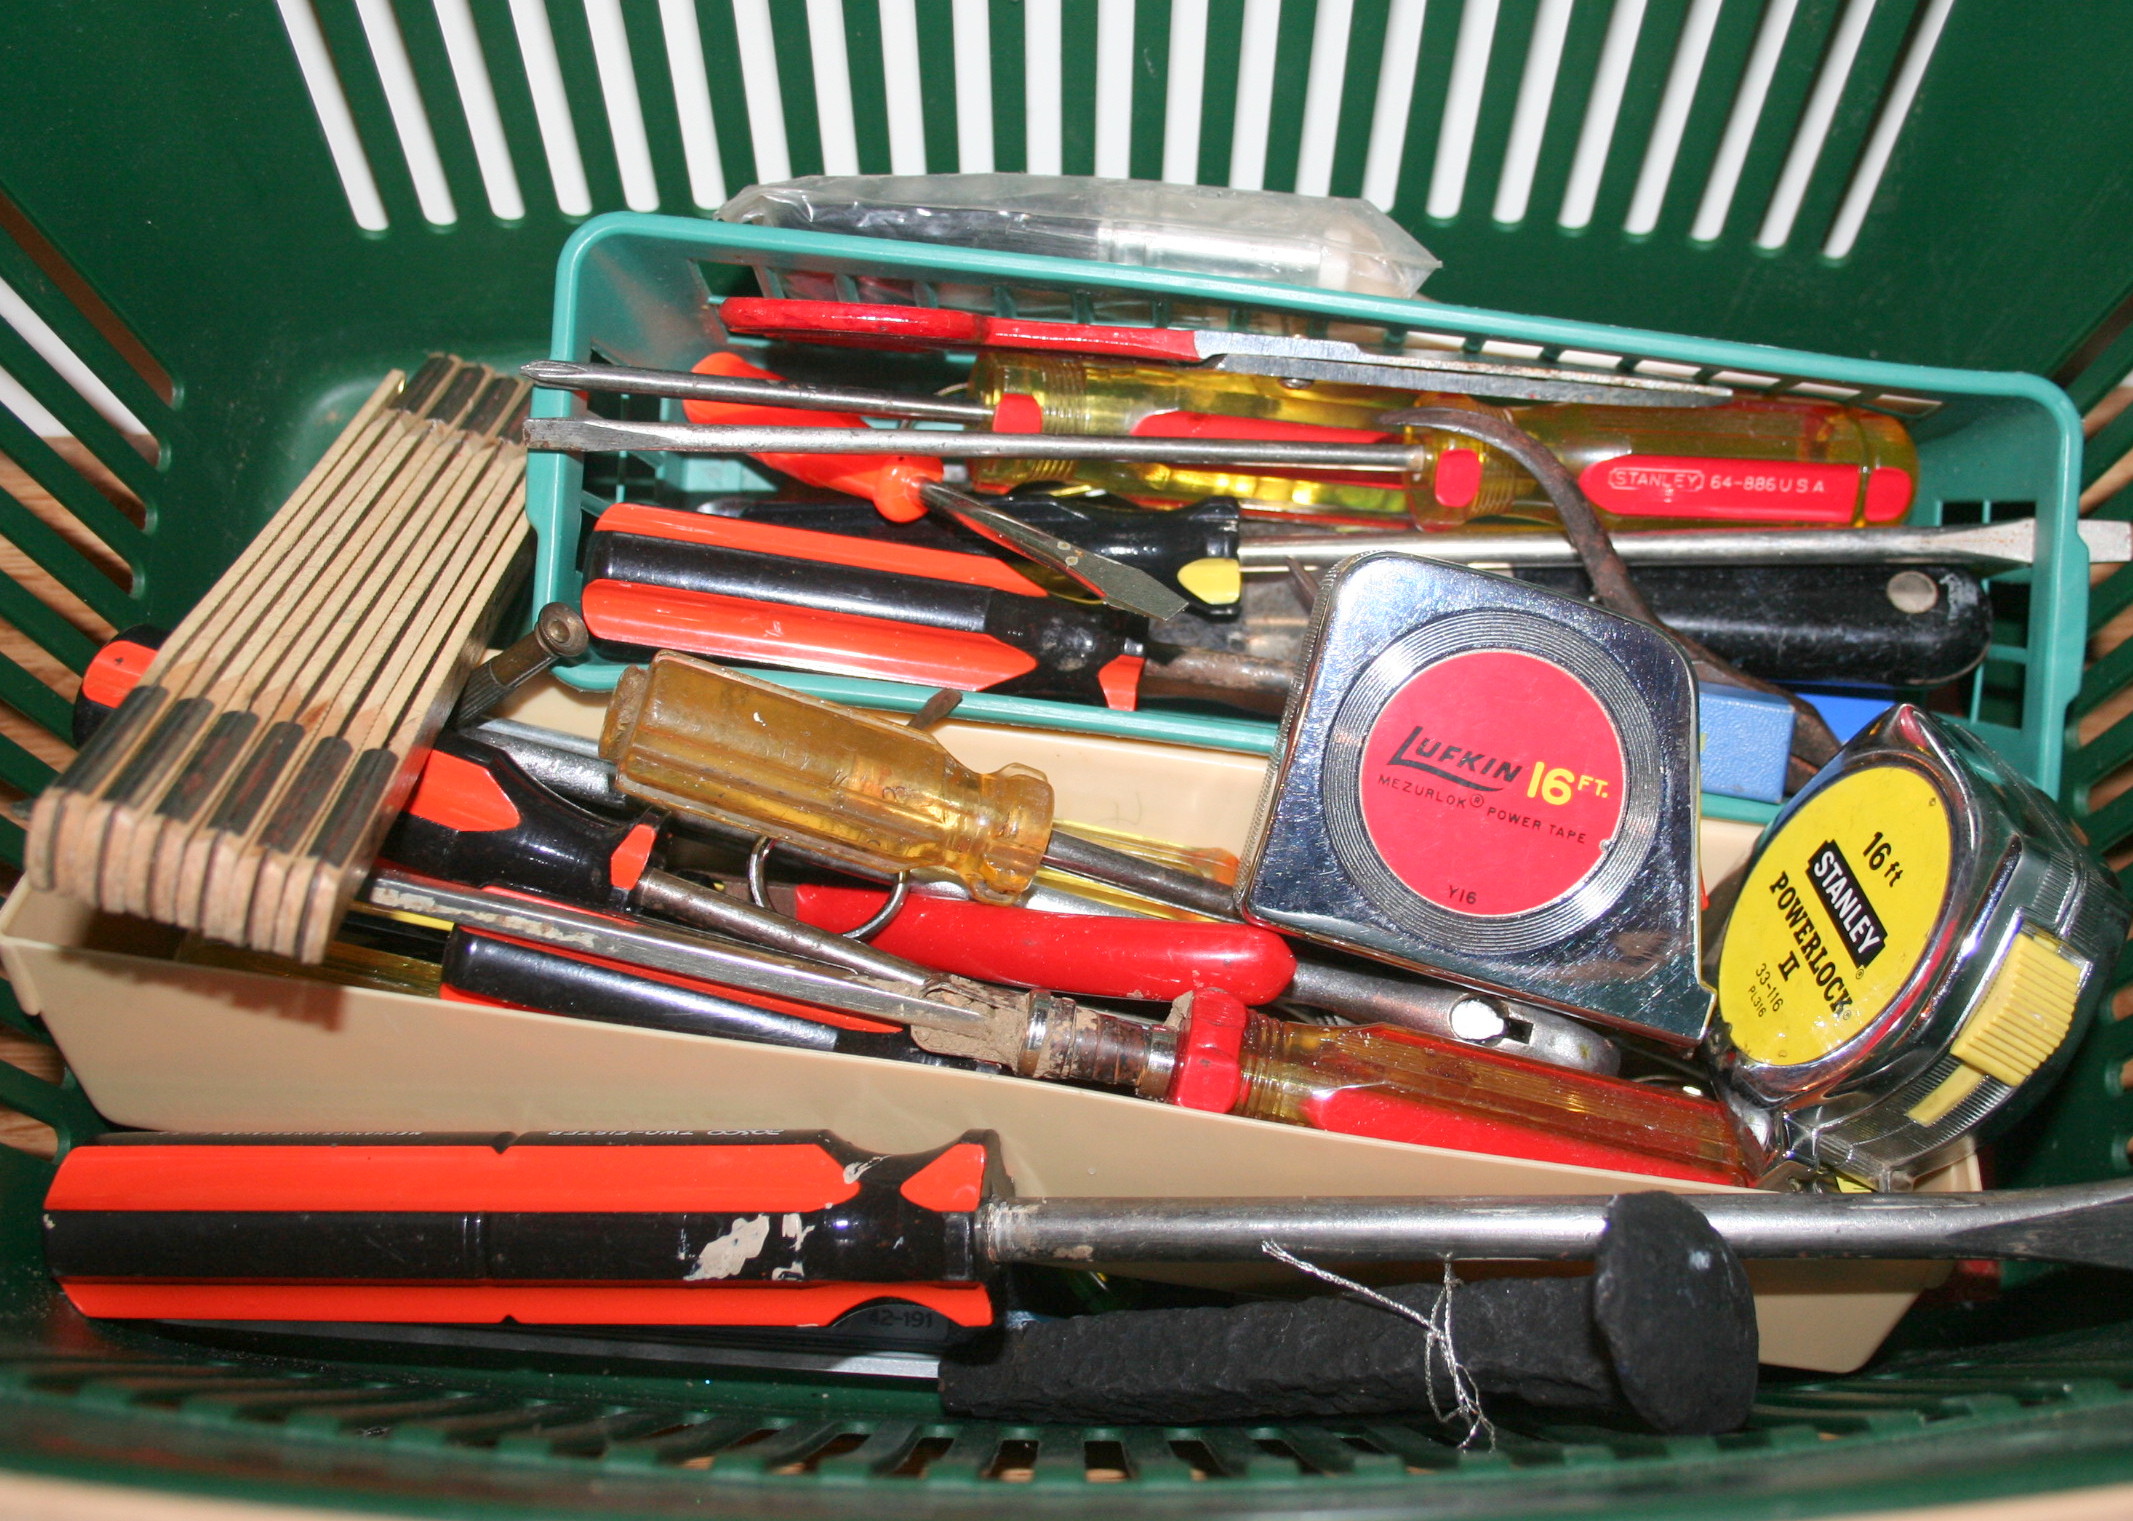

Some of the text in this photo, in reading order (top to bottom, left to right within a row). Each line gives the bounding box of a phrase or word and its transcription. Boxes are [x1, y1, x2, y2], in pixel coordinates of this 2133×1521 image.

[1614, 470, 1699, 488] STANLEY
[1709, 474, 1776, 492] 64-886
[1387, 726, 1610, 806] LUFKIN 16 FT.
[1487, 806, 1541, 831] POWER
[1549, 824, 1587, 845] TAPE
[1862, 831, 1904, 888] 16 ft
[1448, 885, 1477, 905] Y16
[1813, 850, 1881, 954] STANLEY
[1769, 870, 1854, 1014] POWERLOCK
[1778, 950, 1801, 983] II
[1748, 984, 1767, 1018] PL316
[1755, 962, 1784, 1013] 33-116
[868, 1307, 934, 1329] 42-191
